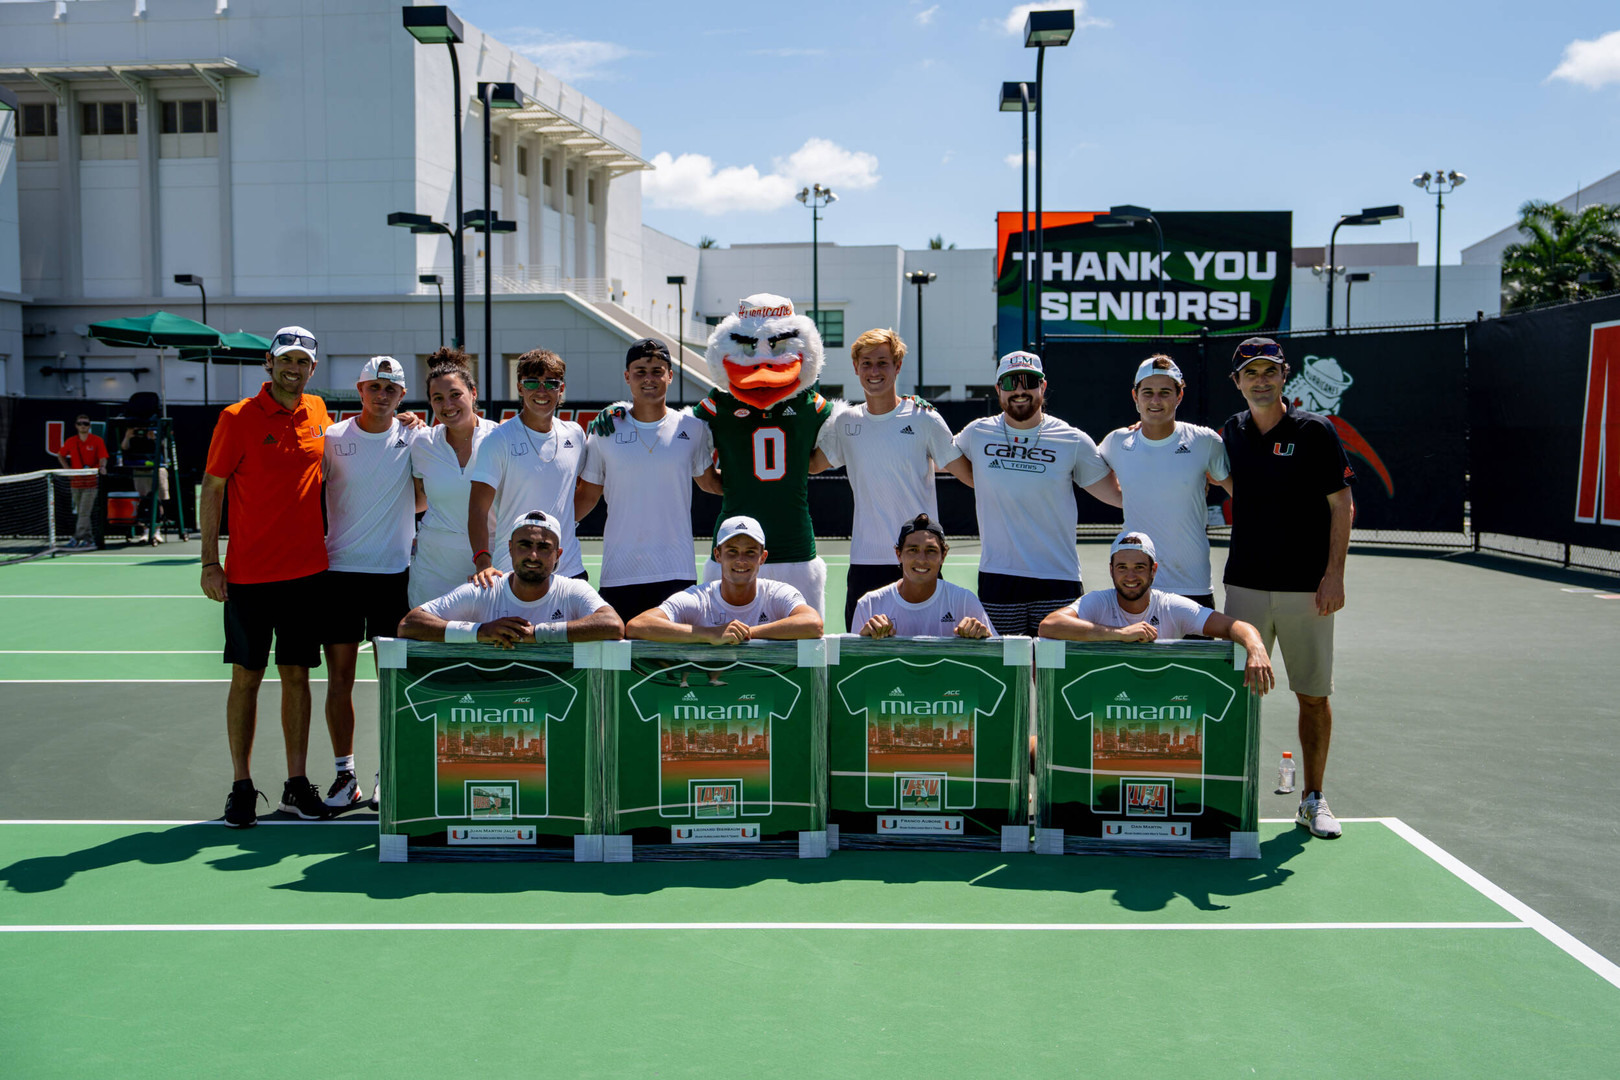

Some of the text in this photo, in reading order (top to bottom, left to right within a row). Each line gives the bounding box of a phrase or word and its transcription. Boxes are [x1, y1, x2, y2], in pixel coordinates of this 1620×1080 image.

[1012, 251, 1277, 281] THANK YOU
[1040, 291, 1251, 321] SENIORS!
[310, 424, 324, 439] U
[1013, 436, 1029, 444] U
[752, 426, 787, 482] 0
[1272, 442, 1295, 456] U
[881, 819, 898, 829] U
[945, 820, 960, 831] U
[452, 830, 469, 840] U
[517, 830, 534, 841] U
[676, 829, 693, 839] U
[741, 828, 757, 838] U
[1106, 825, 1122, 835] U
[1170, 826, 1187, 837] U
